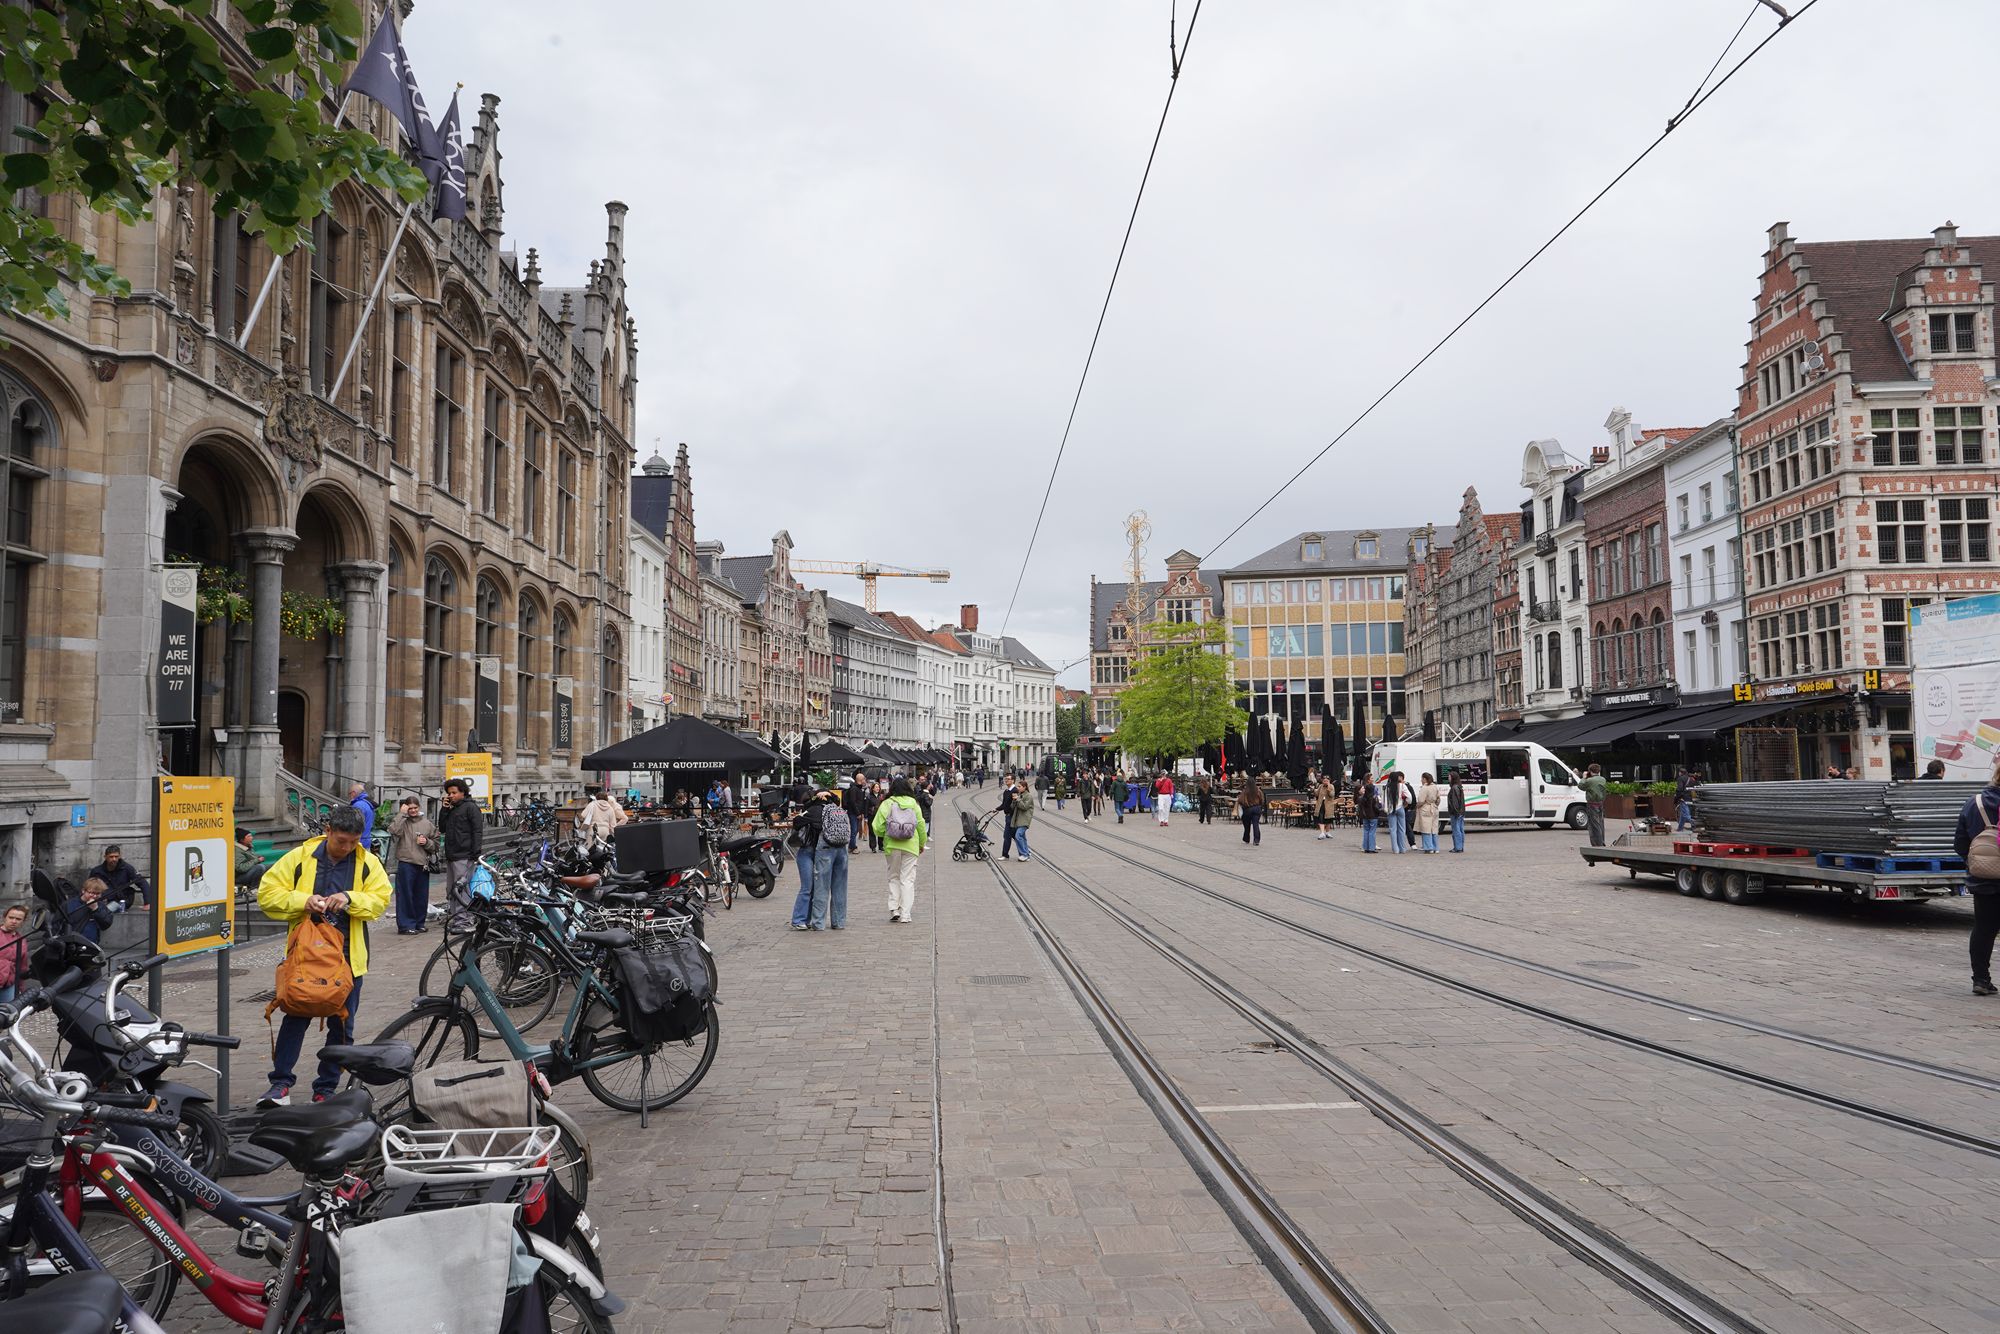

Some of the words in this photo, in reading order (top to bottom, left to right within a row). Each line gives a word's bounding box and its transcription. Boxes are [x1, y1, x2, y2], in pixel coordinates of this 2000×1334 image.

[1233, 581, 1321, 604] BASIC
[1333, 580, 1382, 601] FIT
[168, 634, 187, 646] WE
[1271, 629, 1303, 654] &A
[165, 650, 189, 661] ARE
[161, 664, 192, 676] OPEN
[168, 680, 184, 691] 7/7
[1766, 683, 1796, 696] Hawaiian
[1441, 746, 1481, 759] Pierino
[672, 761, 726, 769] QUOTIDIEN
[169, 802, 224, 814] ALTERNATIEVE
[169, 817, 224, 831] VELOPARKING
[137, 1137, 222, 1207] OXFORD
[115, 1184, 129, 1200] DE
[126, 1197, 186, 1262] FIETSAMBASSADE
[182, 1258, 204, 1280] GENT
[271, 1231, 297, 1308] REFLECTION
